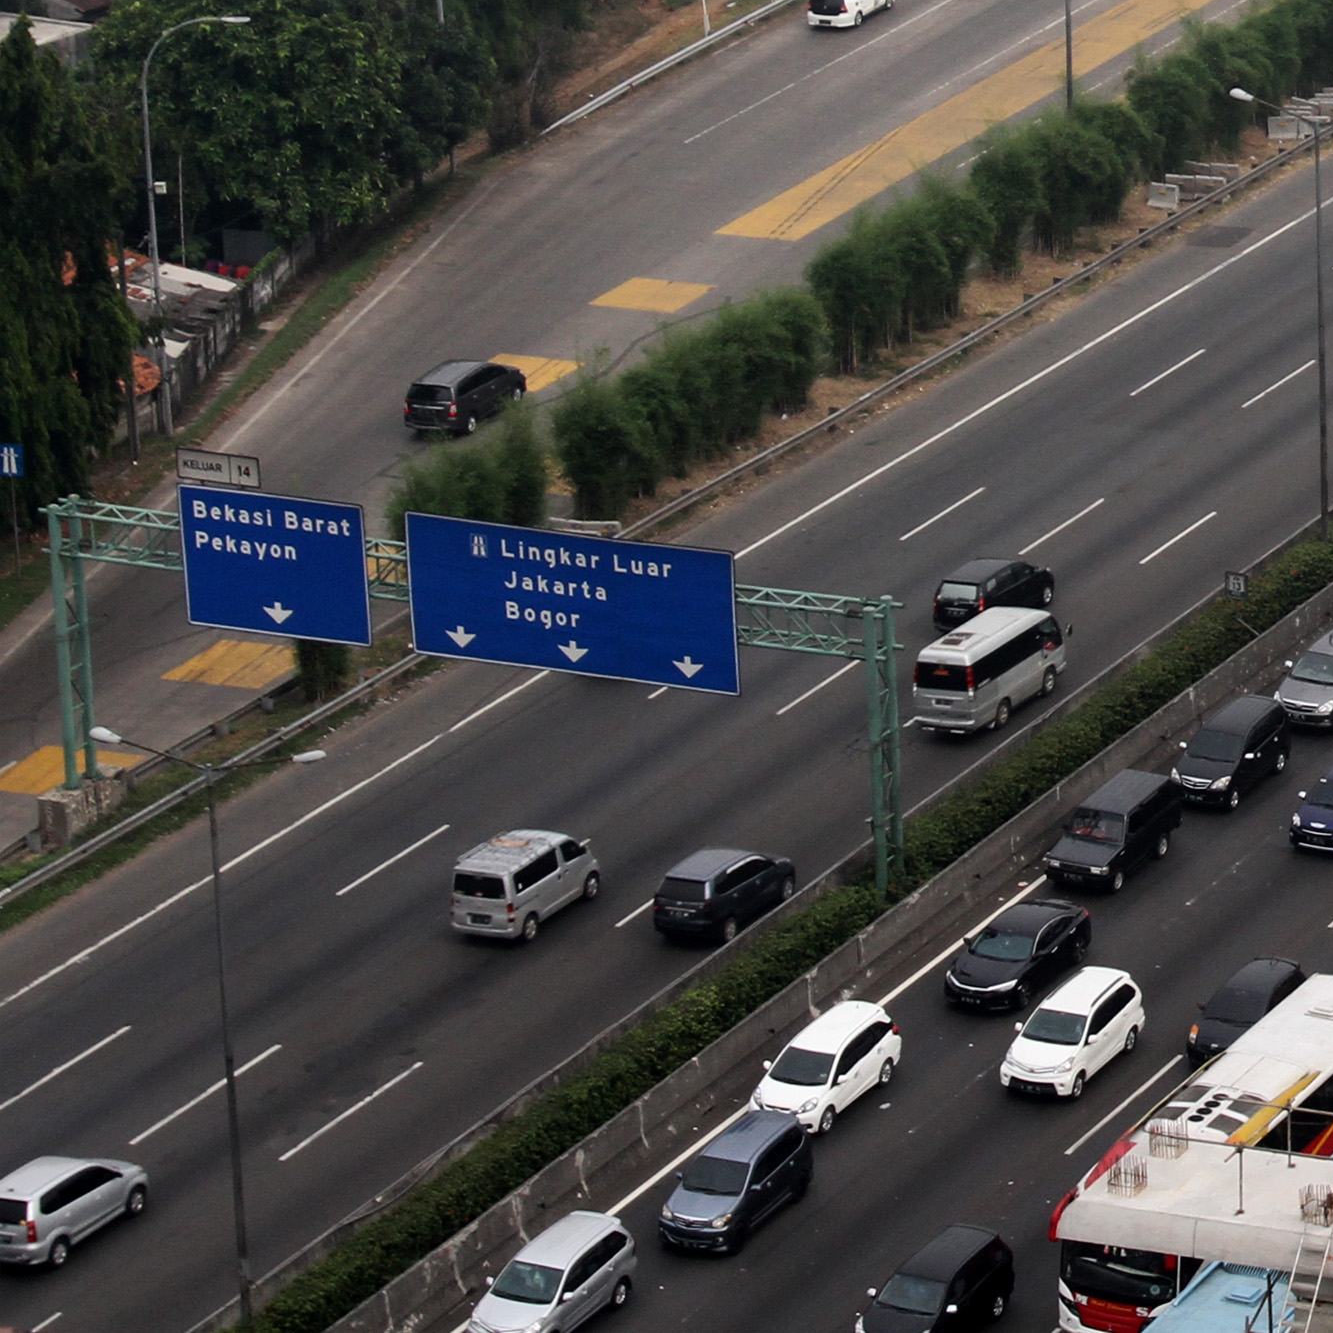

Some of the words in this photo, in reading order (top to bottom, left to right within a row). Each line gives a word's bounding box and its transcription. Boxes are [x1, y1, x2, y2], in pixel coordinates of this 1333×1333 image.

[182, 459, 223, 473] KELUAR
[238, 465, 250, 478] 14
[192, 500, 273, 527] Bekasi
[284, 510, 350, 536] Barat
[195, 530, 298, 561] Pekayon
[501, 538, 600, 568] Lingkar
[613, 554, 672, 578] Luar
[504, 570, 608, 601] Jakarta
[505, 600, 580, 630] Bogor
[1074, 1292, 1089, 1306] M
